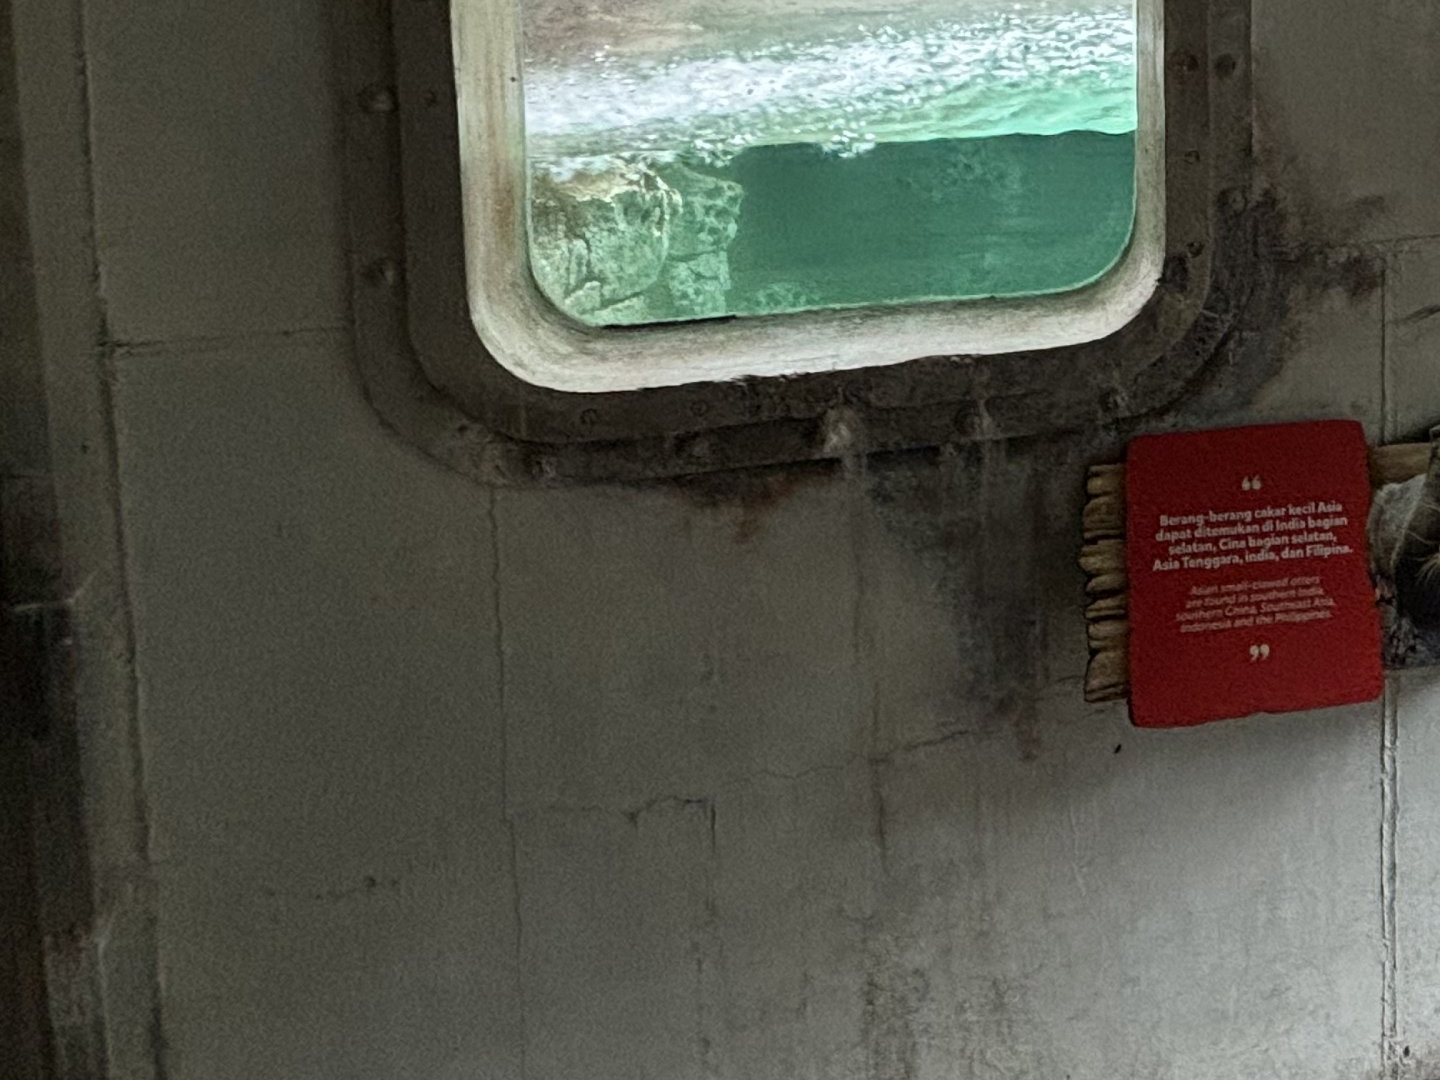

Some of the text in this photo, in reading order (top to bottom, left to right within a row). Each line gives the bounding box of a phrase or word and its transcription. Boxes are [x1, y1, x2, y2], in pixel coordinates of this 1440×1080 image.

[1159, 500, 1343, 526] Berang-berang cakar kecil Asia
[1155, 515, 1348, 543] dapat ditemukan di India bagian
[1168, 530, 1337, 555] selatan, Cina bagian selatan,
[1152, 558, 1181, 571] Asia
[1181, 554, 1243, 570] Tenggara,
[1280, 546, 1304, 559] dan
[1305, 543, 1354, 559] Filipina.
